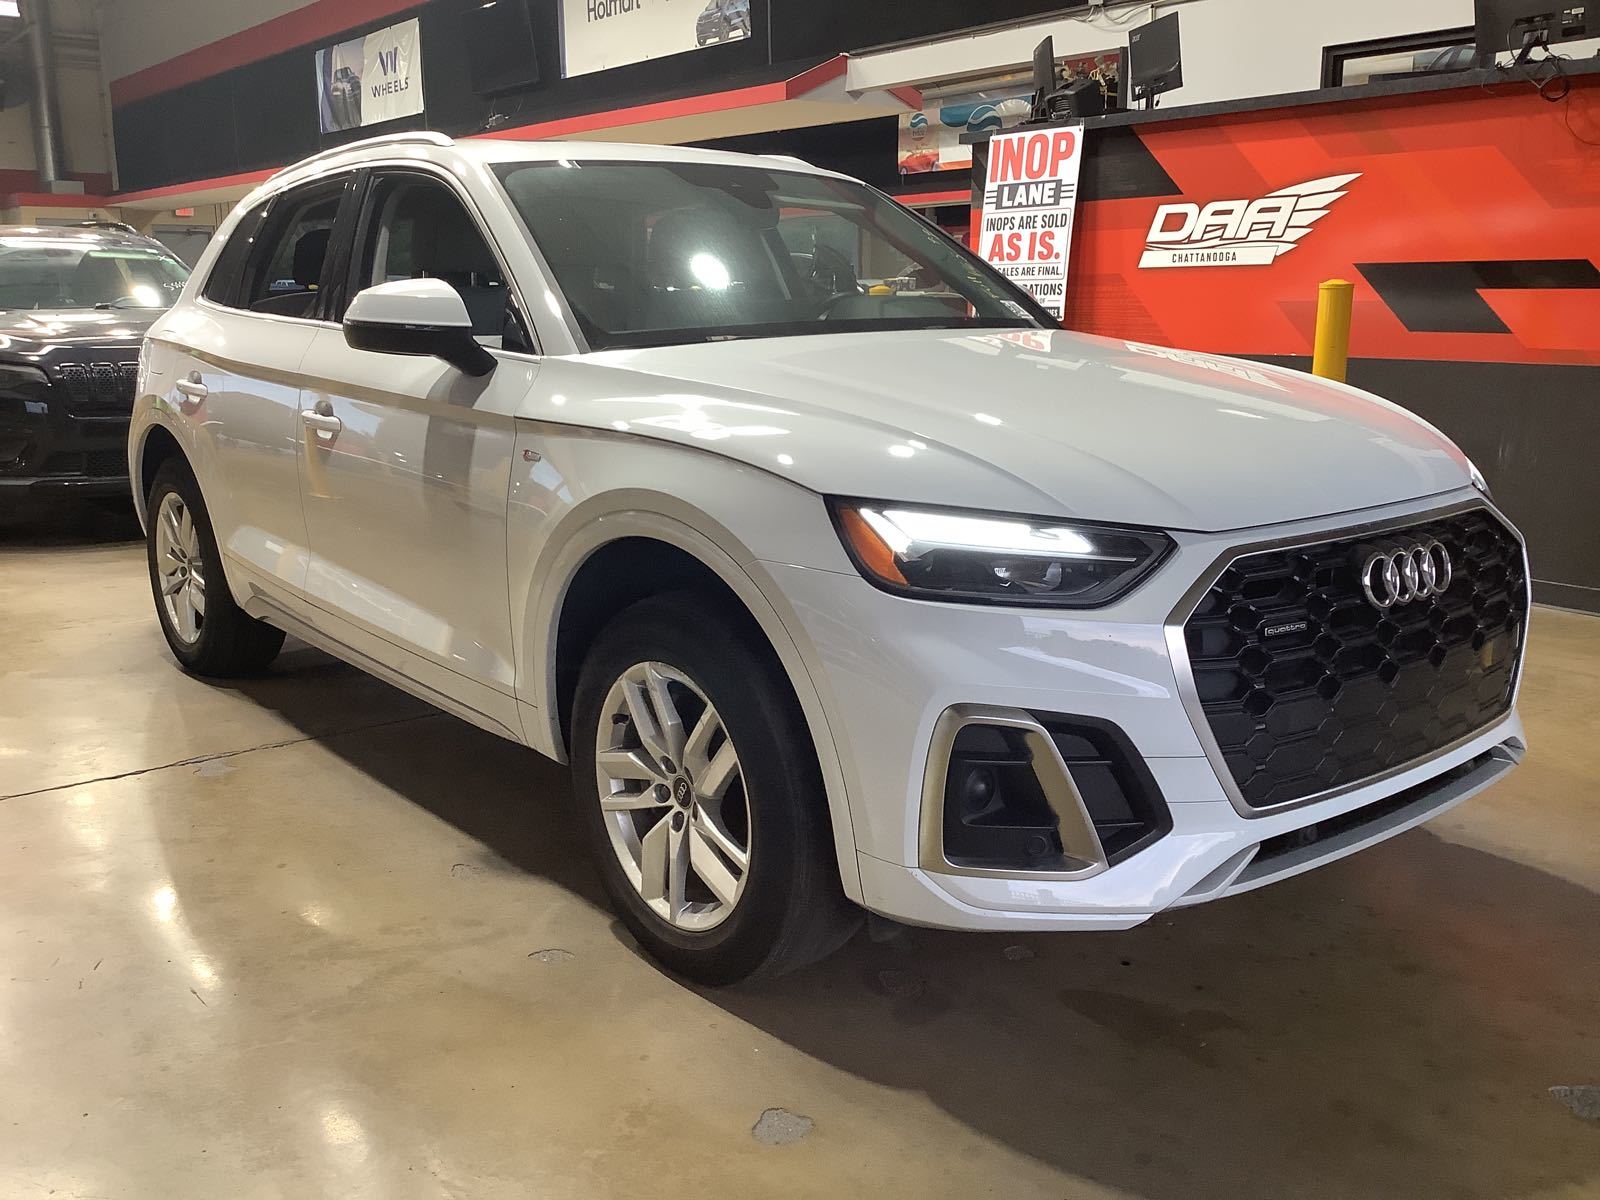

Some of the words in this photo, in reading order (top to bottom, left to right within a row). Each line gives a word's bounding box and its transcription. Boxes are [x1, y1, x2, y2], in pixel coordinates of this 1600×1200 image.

[371, 77, 409, 98] WHEELS
[990, 131, 1076, 183] INOP
[1001, 182, 1057, 207] LANE
[986, 217, 1015, 232] INOPS
[1018, 215, 1037, 230] ARE
[1041, 213, 1067, 228] SOLD
[1146, 196, 1299, 241] DAA
[988, 232, 1021, 261] AS
[1028, 231, 1060, 260] IS.
[1172, 251, 1237, 263] CHATTANOOGA
[1021, 266, 1036, 276] ARE
[1037, 265, 1063, 276] FINAL.
[1267, 623, 1306, 636] quattro
